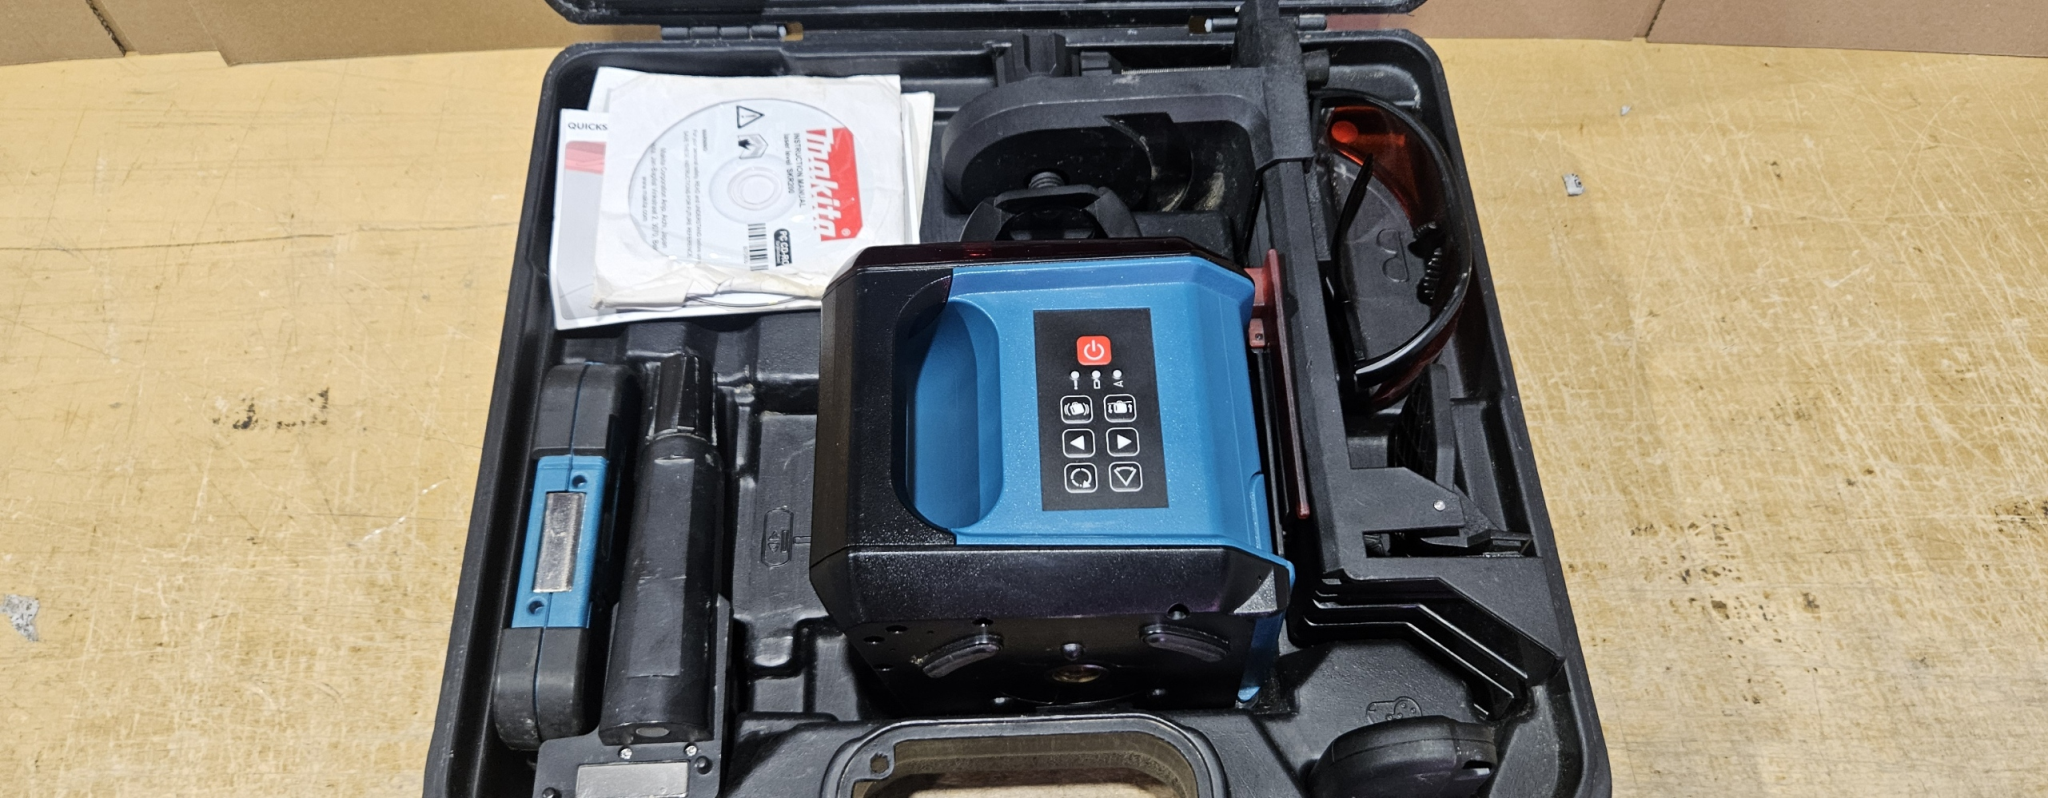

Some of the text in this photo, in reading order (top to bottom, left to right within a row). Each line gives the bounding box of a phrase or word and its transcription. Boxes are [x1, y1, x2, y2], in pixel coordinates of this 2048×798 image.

[786, 168, 795, 194] SKR200
[794, 133, 806, 208] INSTRUCTION MANUAL
[778, 230, 788, 242] PC
